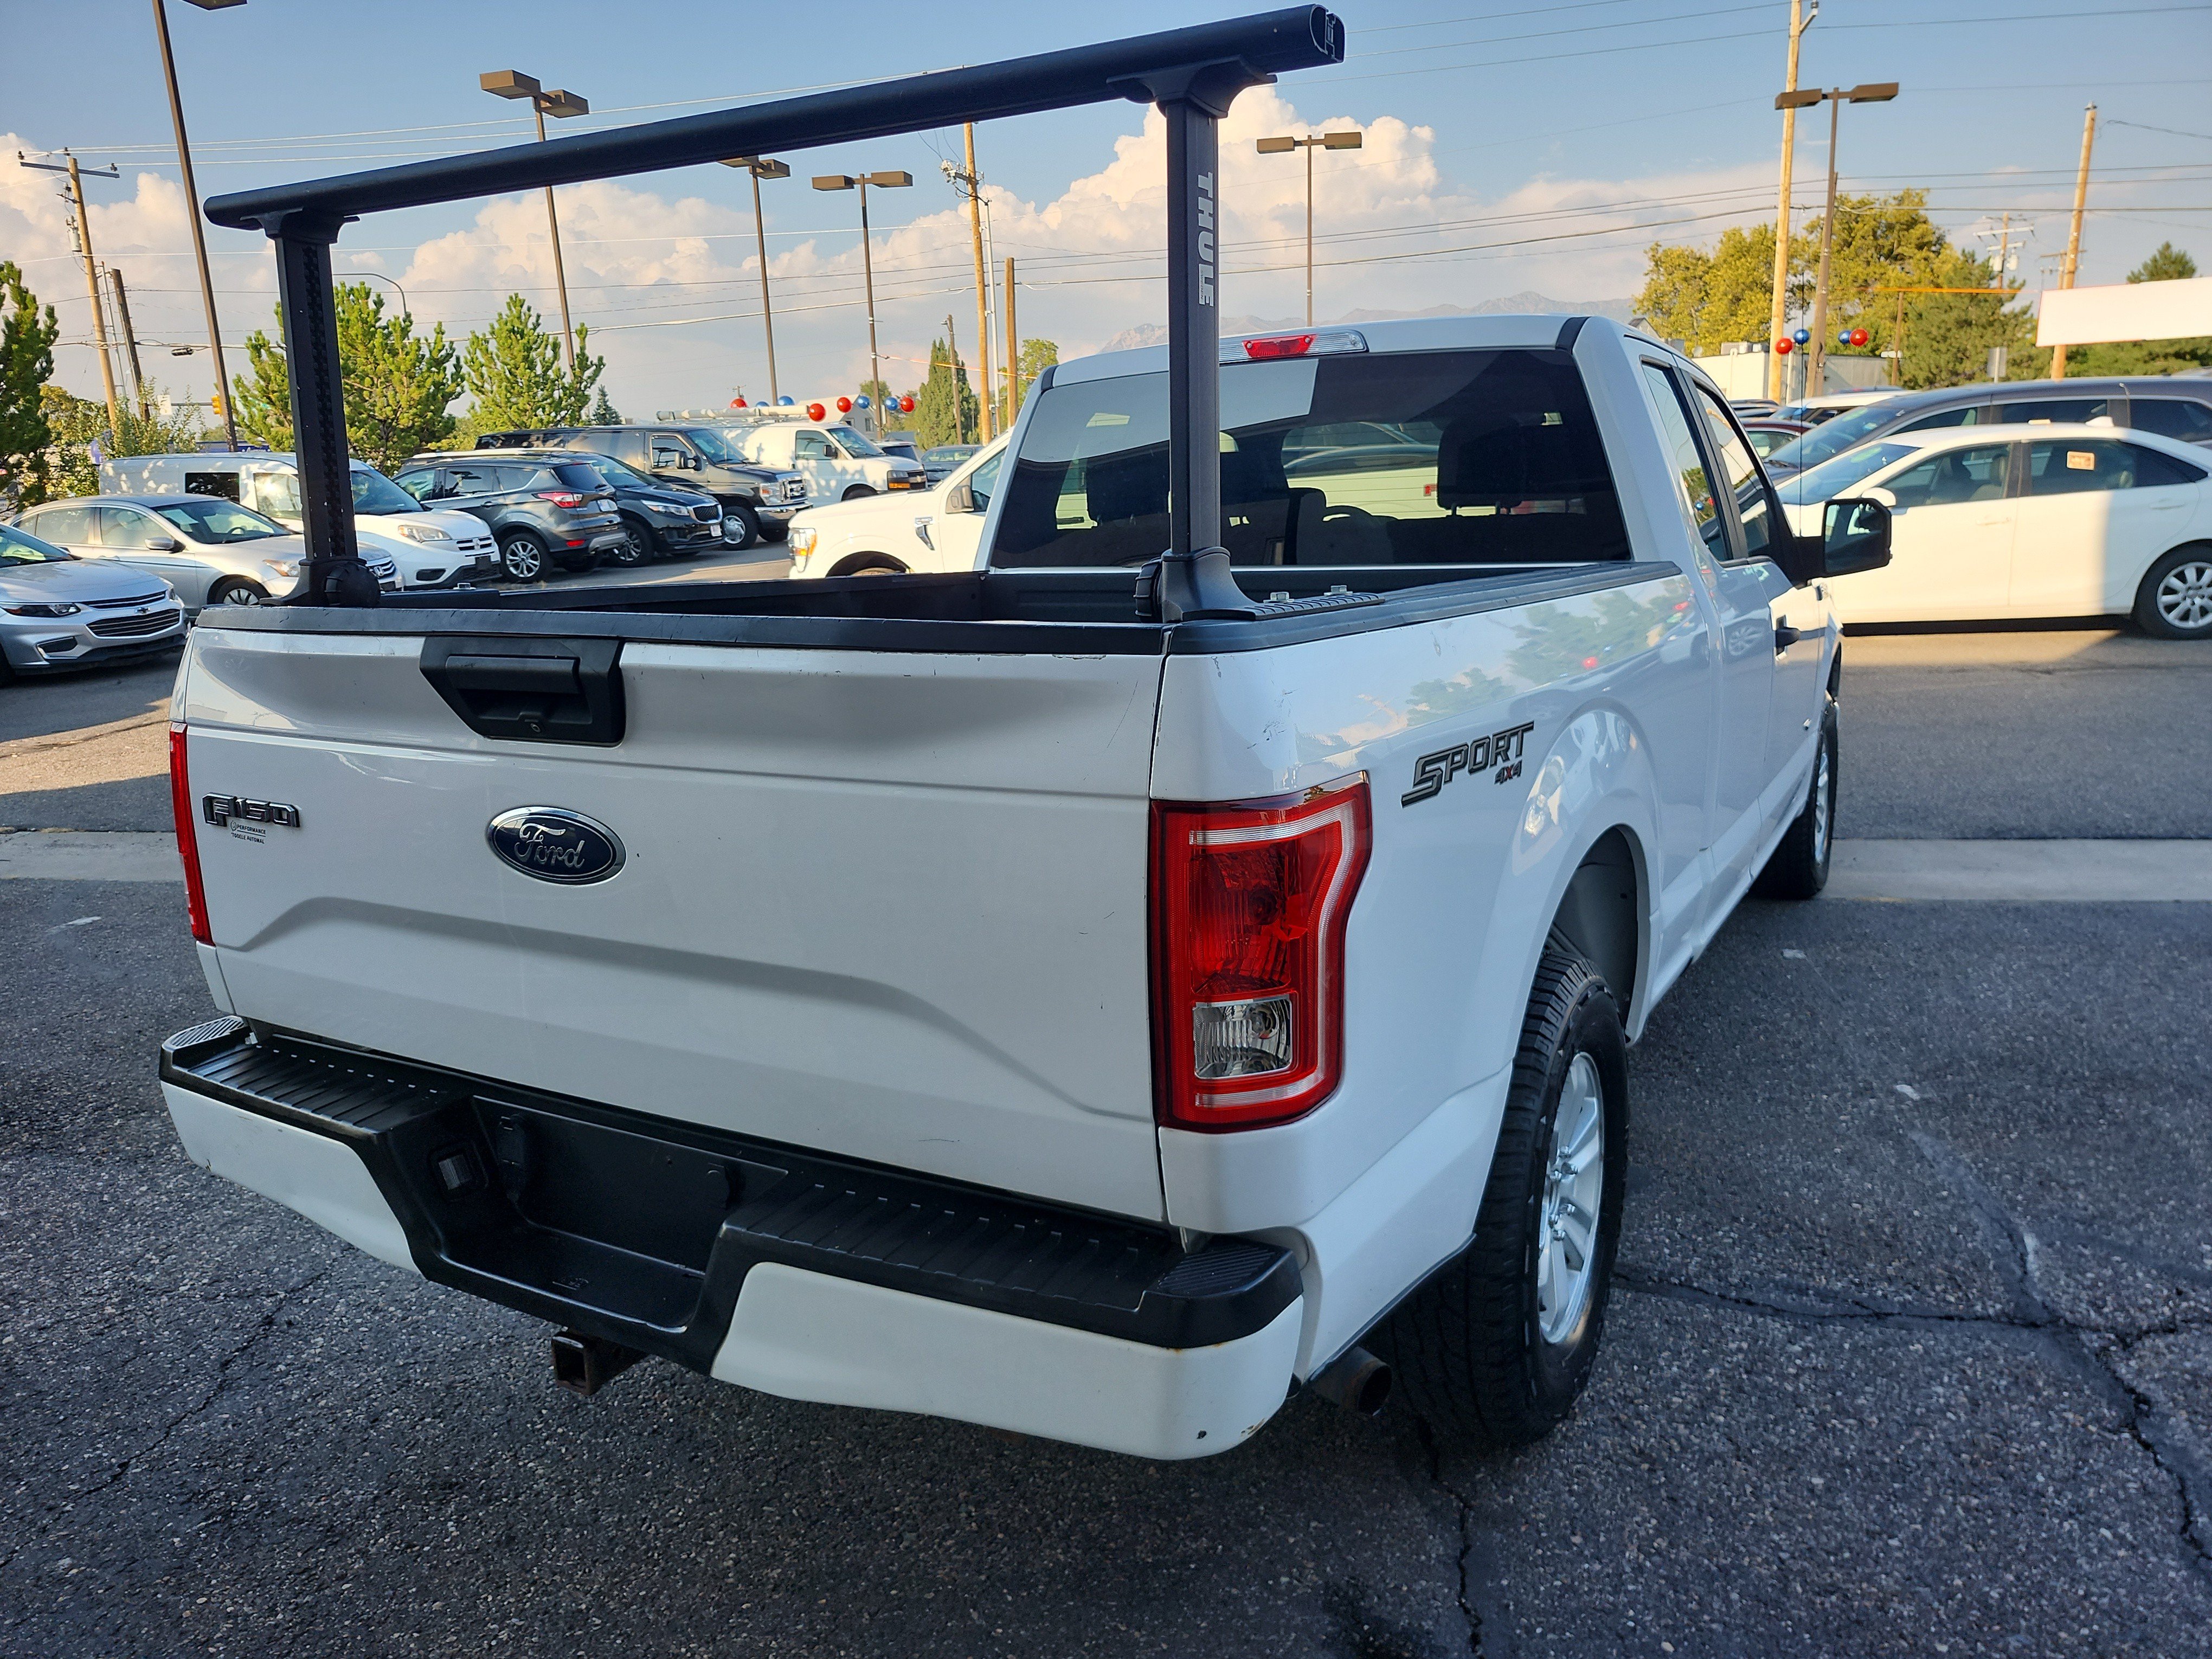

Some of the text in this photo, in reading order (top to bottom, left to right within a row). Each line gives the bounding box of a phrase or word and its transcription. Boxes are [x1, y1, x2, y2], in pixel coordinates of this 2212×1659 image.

[1198, 171, 1214, 307] THULE
[1401, 720, 1534, 808] SPORT
[237, 824, 266, 835] PERFORMANCE
[514, 822, 586, 869] Ford
